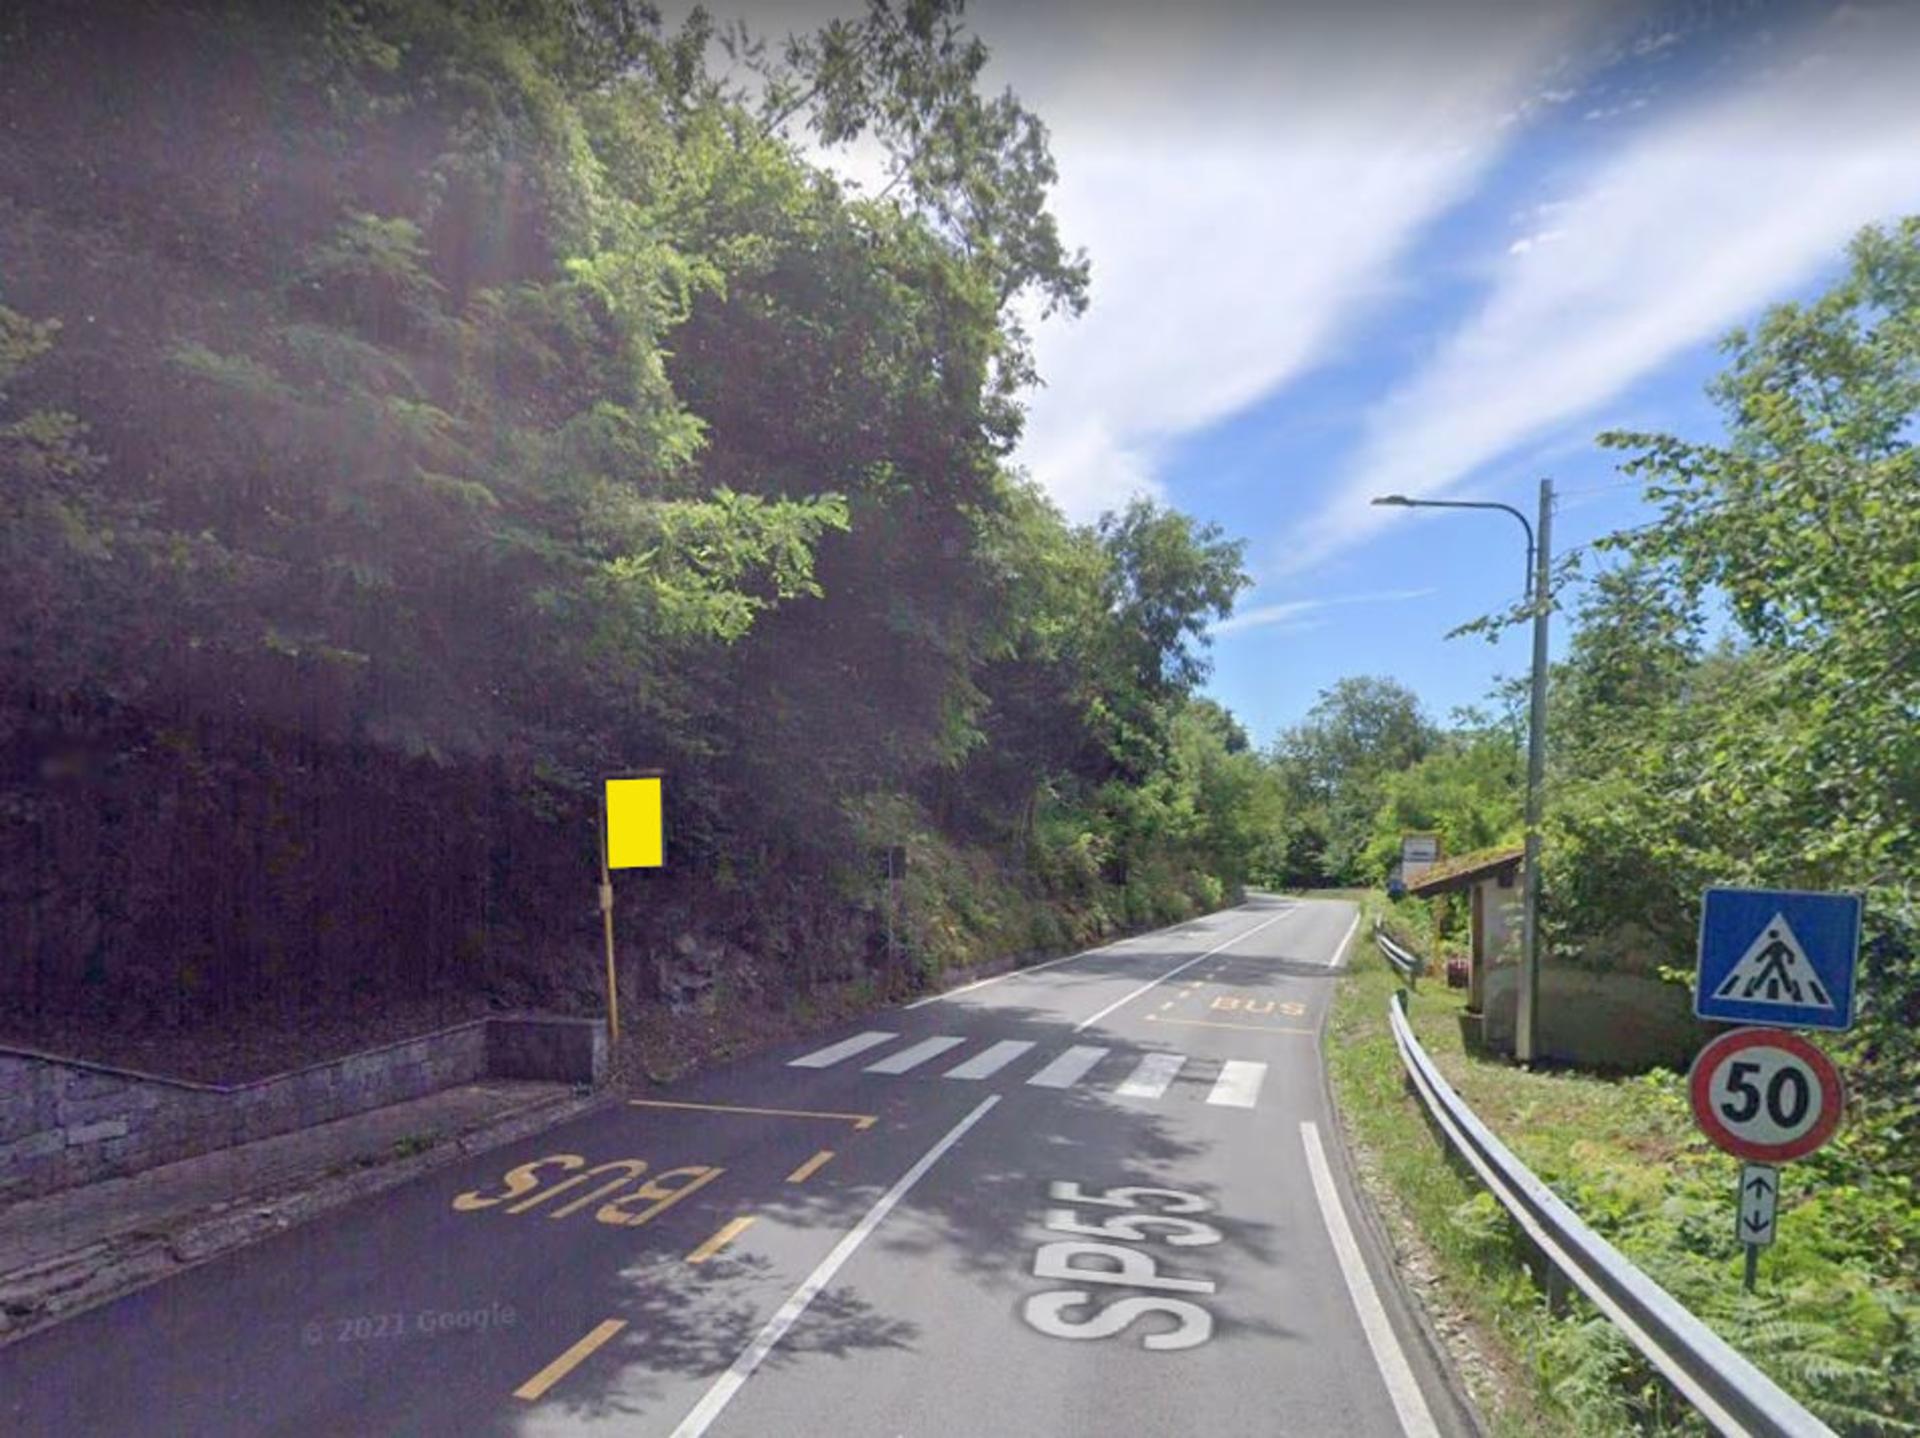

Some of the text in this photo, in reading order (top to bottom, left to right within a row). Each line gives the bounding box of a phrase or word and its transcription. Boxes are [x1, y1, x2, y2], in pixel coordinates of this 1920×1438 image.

[1211, 996, 1306, 1016] BUS
[1721, 1062, 1810, 1128] 50
[452, 1154, 727, 1226] BUS
[1024, 1180, 1223, 1350] SP55
